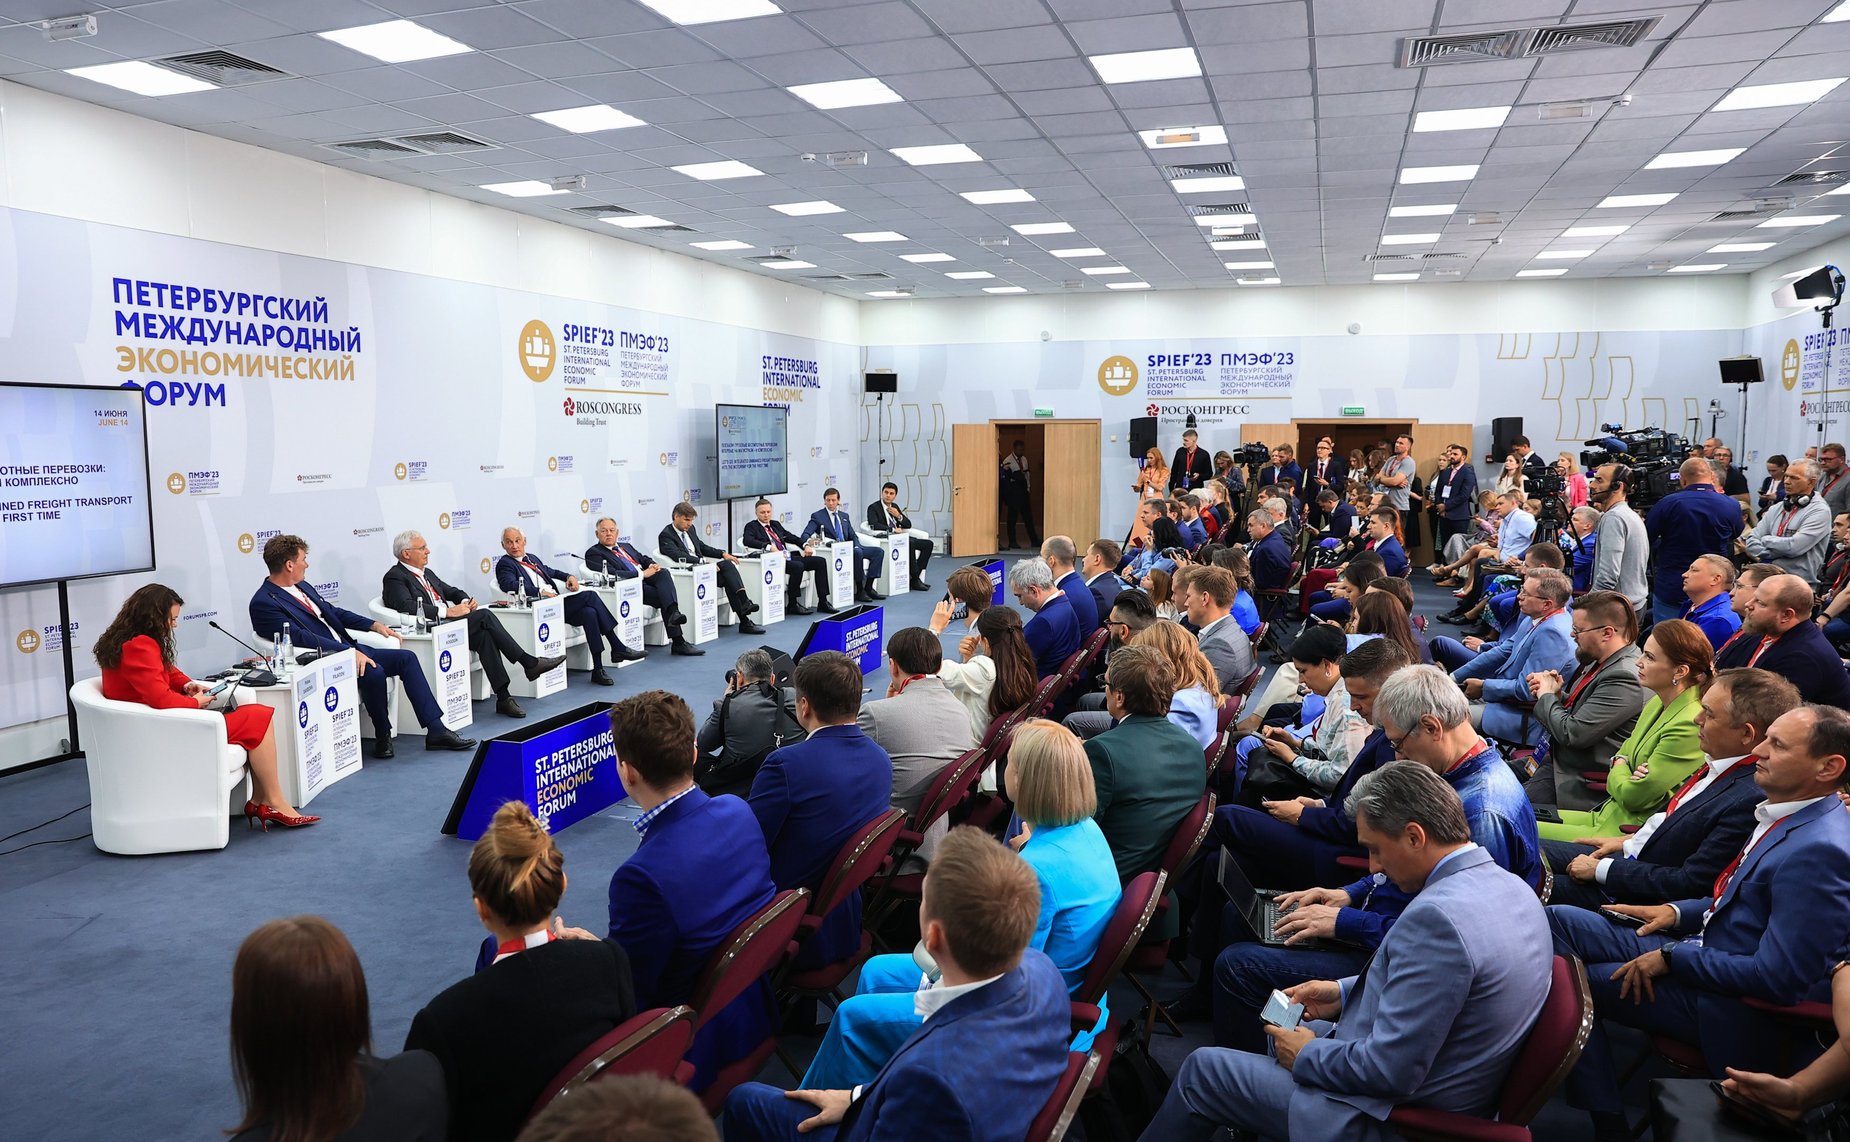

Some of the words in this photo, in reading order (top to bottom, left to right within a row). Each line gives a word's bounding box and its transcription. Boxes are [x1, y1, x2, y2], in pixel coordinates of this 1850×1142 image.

[112, 277, 329, 324] ПЕТЕРБУРГСКИЙ
[114, 310, 361, 353] МЕЖДУНАРОДНЫЙ
[563, 323, 614, 347] SPIEF'23
[620, 331, 669, 353] ПМЭФ'23
[573, 345, 609, 358] PETERSBURG
[115, 345, 355, 381] ЭКОНОМИЧЕСКИЙ
[564, 355, 611, 367] INTERNATIONAL
[762, 355, 773, 370] ST.
[774, 356, 818, 375] PETERSBURG
[1147, 353, 1212, 367] SPIEF'23
[1221, 352, 1294, 366] ПМЭФ'23
[564, 365, 596, 376] ECONOMIC
[1220, 366, 1282, 374] ПЕТЕРБУРГСКИЙ
[1220, 373, 1293, 381] МЕЖДУНАРОДНЫЙ
[564, 375, 586, 385] FORUM
[763, 371, 821, 389] INTERNATIONAL
[1220, 380, 1291, 388] ЭКОНОМИЧЕСКИЙ
[120, 380, 226, 407] ОРУМ
[763, 387, 803, 402] ECONOMIC
[576, 401, 642, 415] ROSCONGRESS
[1161, 405, 1250, 415] РОСКОНГРЕСС
[43, 464, 106, 475] ПЕРЕВОЗКИ:
[5, 476, 79, 487] КОМПЛЕКСНО
[27, 498, 72, 510] FREIGHT
[75, 495, 133, 507] TRANSPORT
[2, 512, 34, 523] FIRST
[36, 510, 61, 520] TIME
[535, 755, 550, 774] ST.
[551, 729, 614, 767] PETERSBURG
[537, 767, 594, 805] ECONOMIC
[538, 789, 577, 820] FORUM
